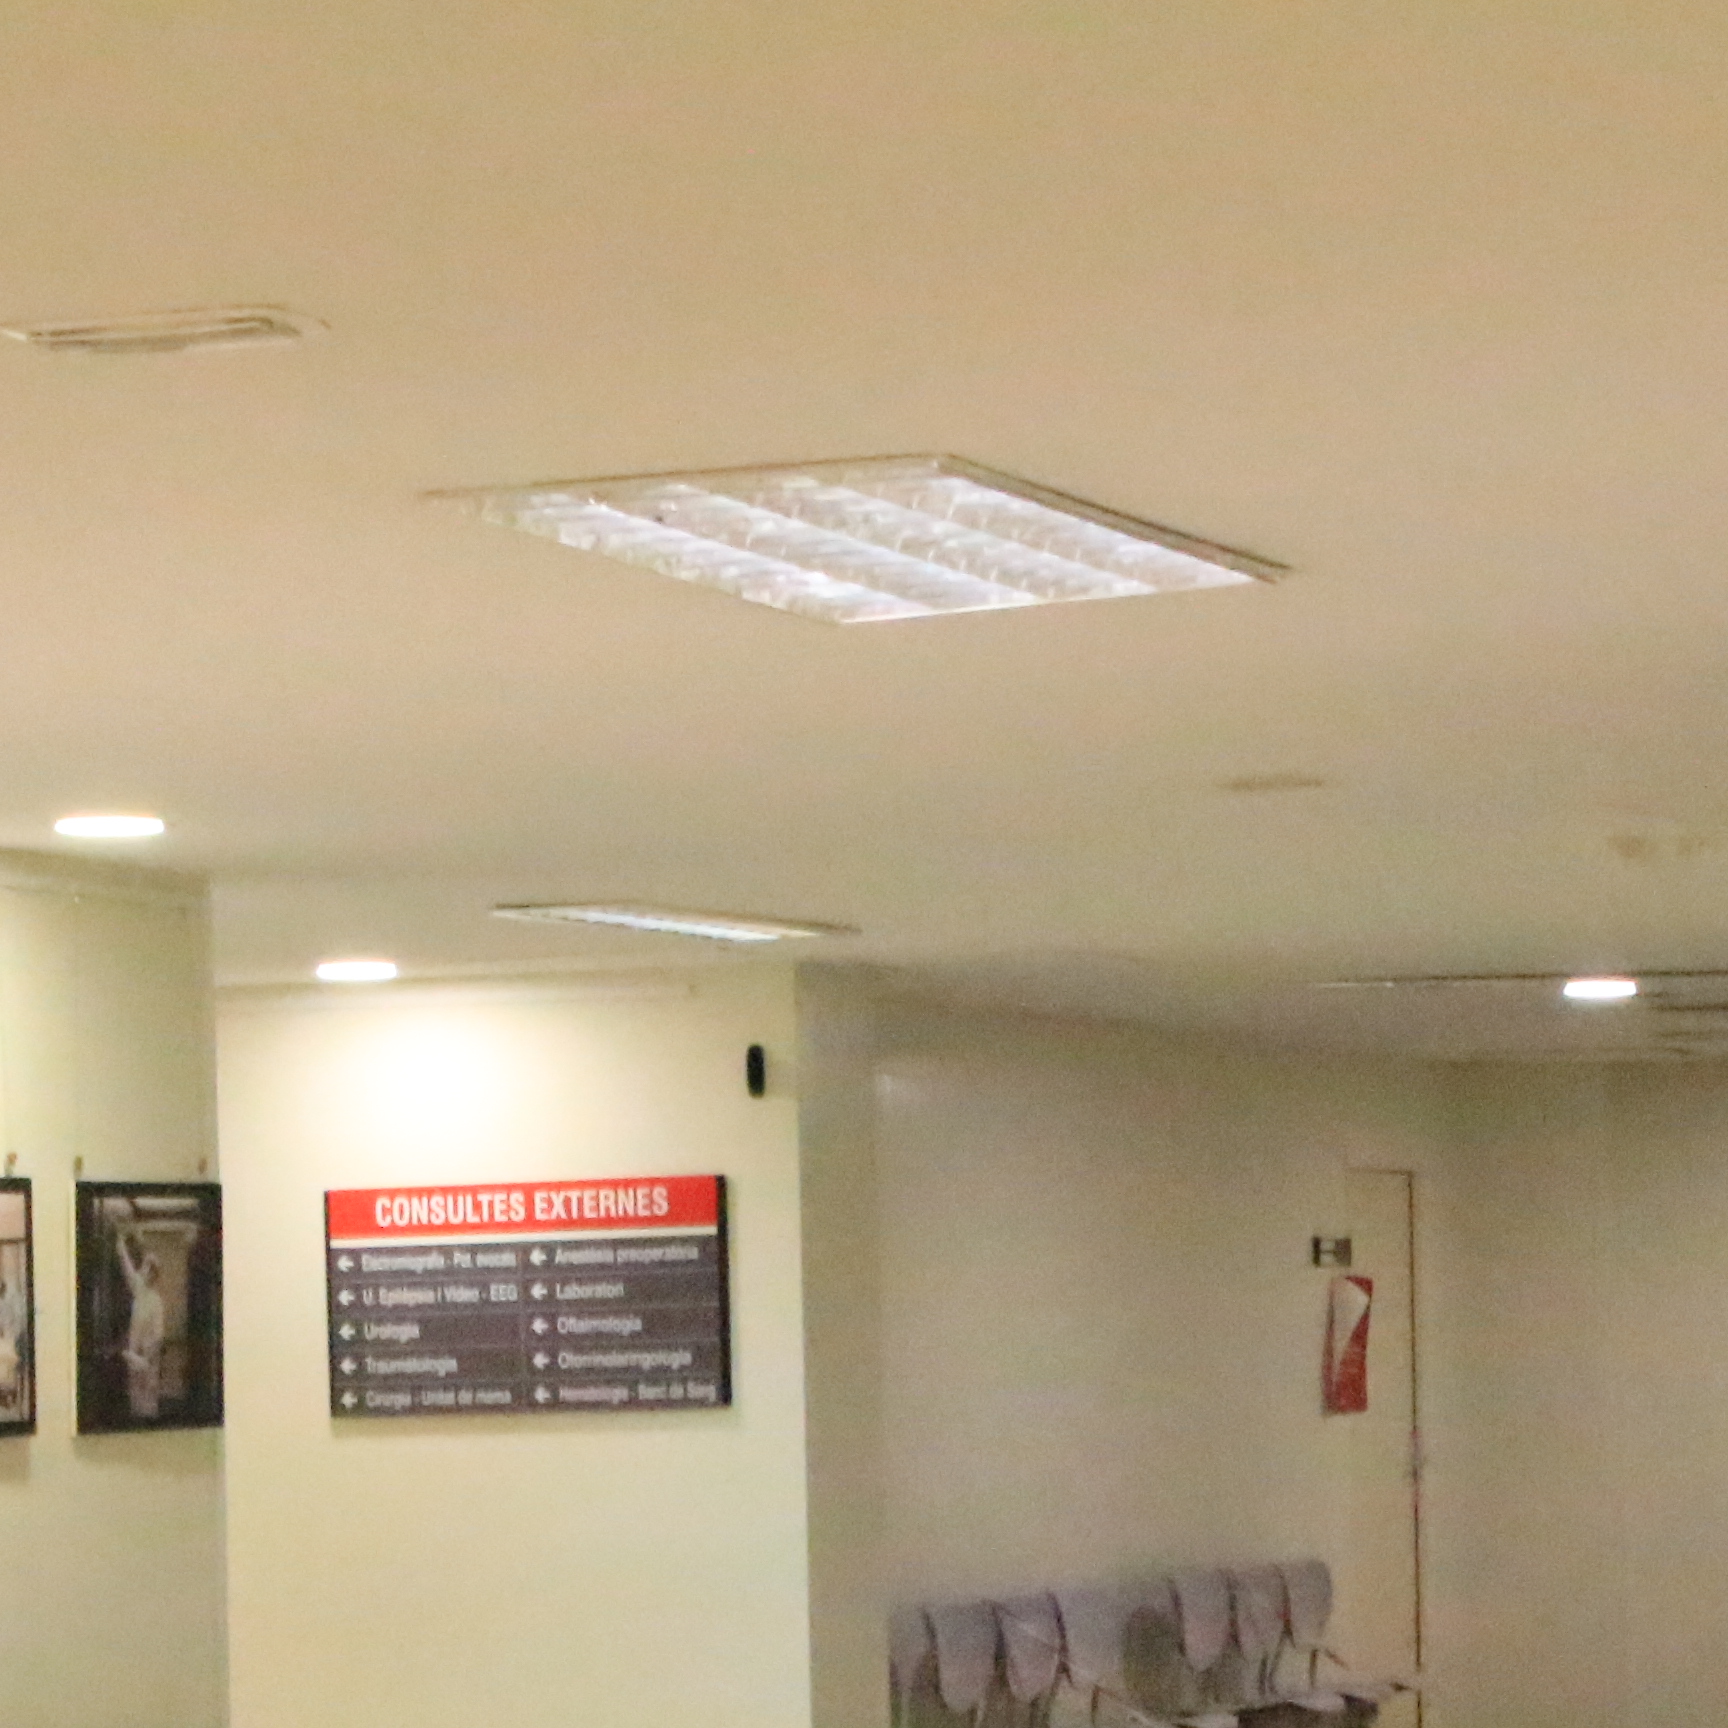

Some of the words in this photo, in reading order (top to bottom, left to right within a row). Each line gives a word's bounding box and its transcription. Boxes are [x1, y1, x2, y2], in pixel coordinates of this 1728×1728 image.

[375, 1190, 526, 1228] CONSULTES
[534, 1186, 670, 1222] EXTERNES
[556, 1282, 625, 1300] Laboratori
